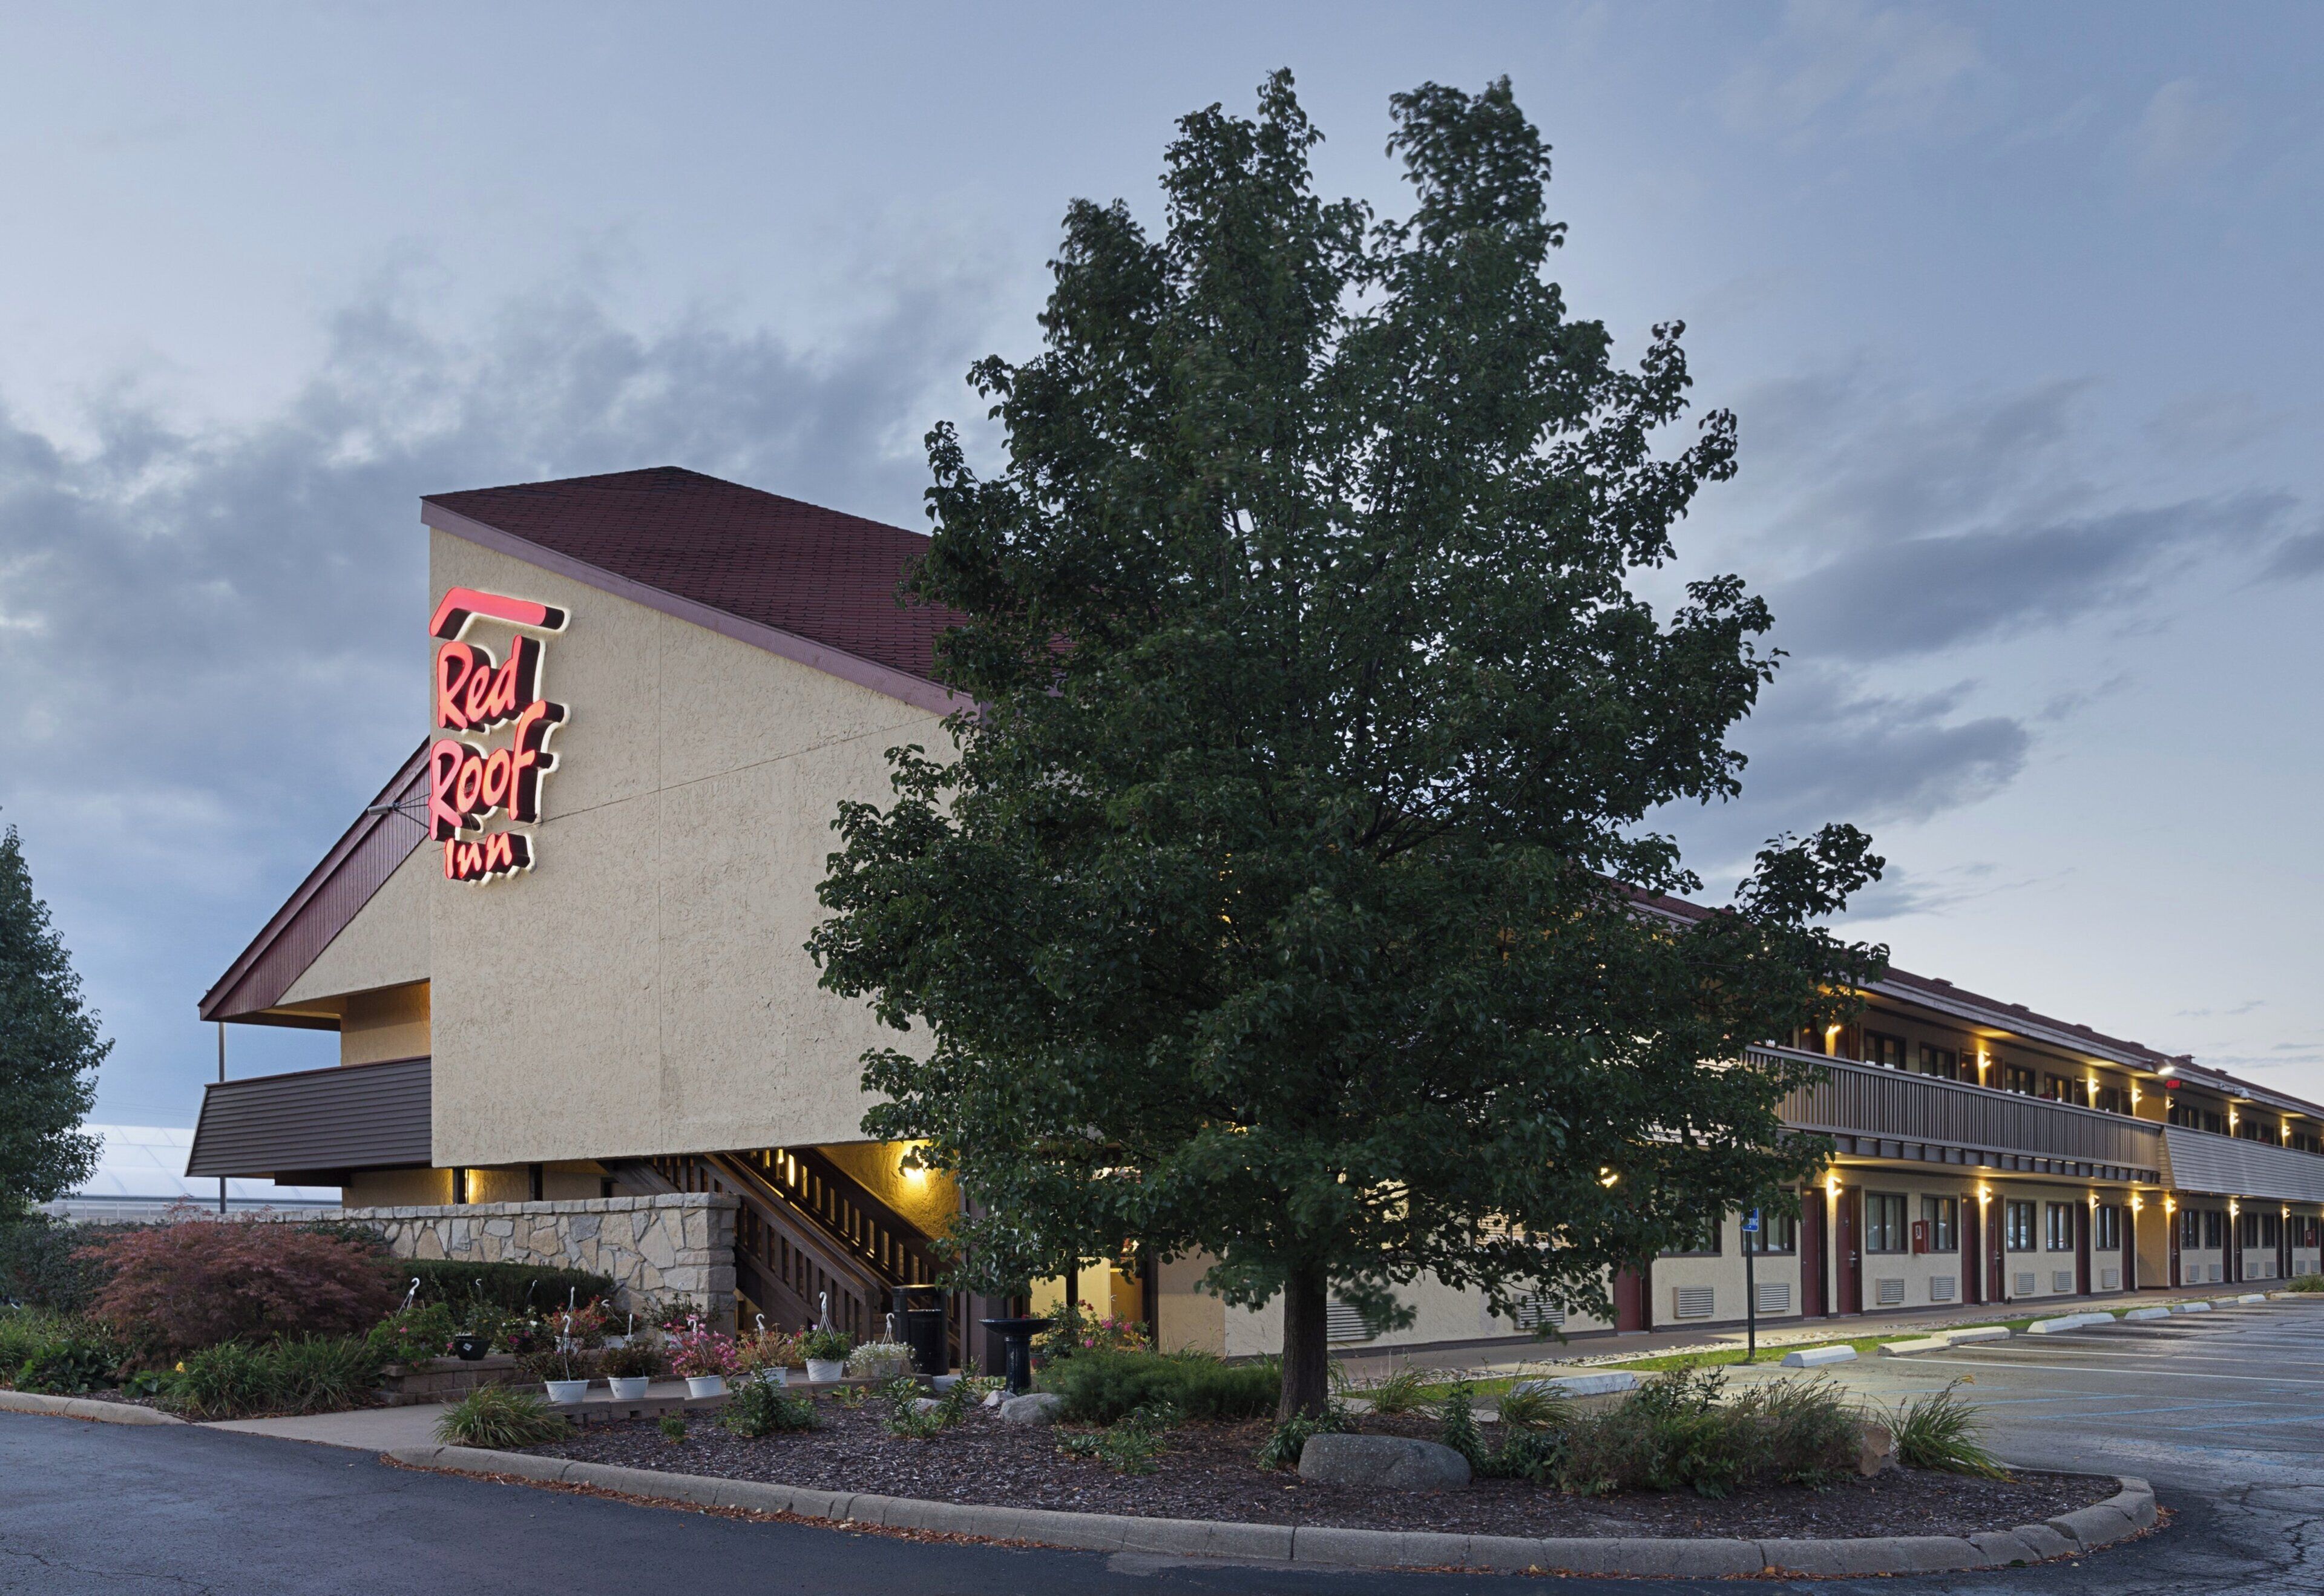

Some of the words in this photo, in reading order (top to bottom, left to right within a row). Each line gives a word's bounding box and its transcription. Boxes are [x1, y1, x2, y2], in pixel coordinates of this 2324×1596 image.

[437, 634, 522, 729] Red
[428, 700, 547, 841] Roof
[444, 832, 513, 880] Inn
[2167, 1080, 2180, 1088] EXIT
